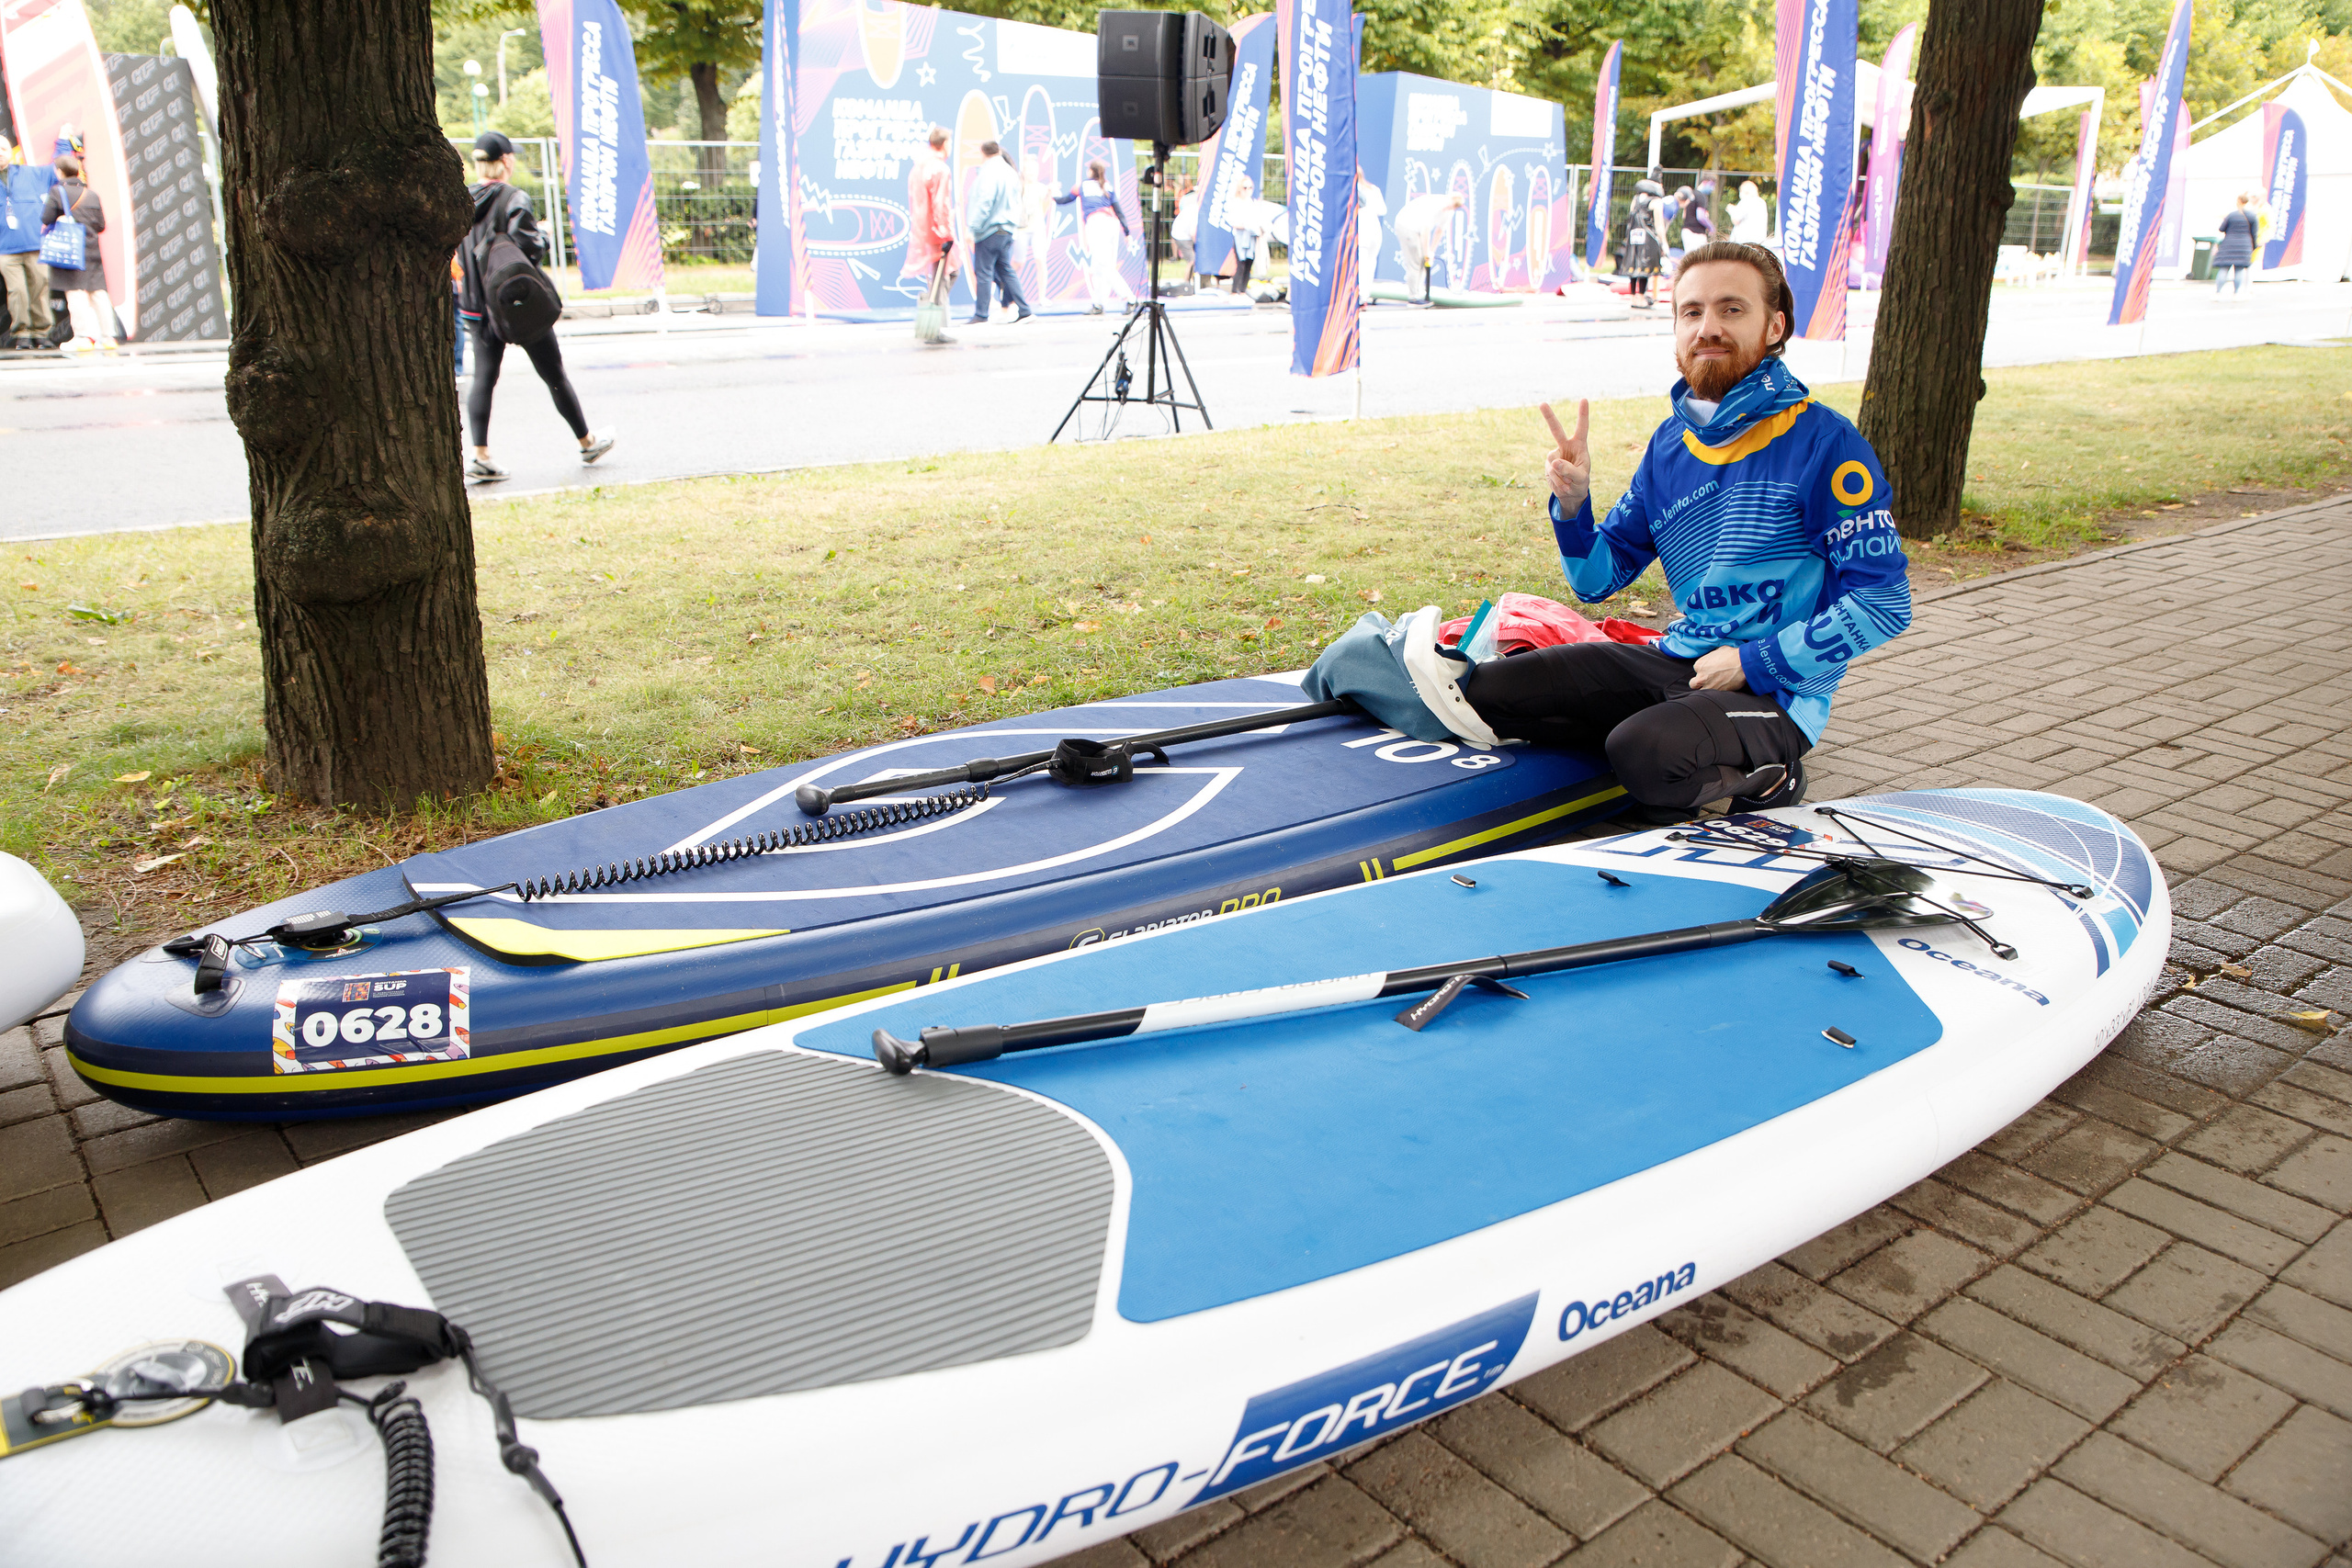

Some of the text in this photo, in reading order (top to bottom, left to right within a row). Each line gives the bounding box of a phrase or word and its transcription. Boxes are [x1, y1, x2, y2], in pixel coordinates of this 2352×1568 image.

[1305, 18, 1333, 288] ГАЗПРОМ НЕФТИ
[1799, 63, 1838, 272] ГАЗПРОМ НЕФТИ
[1289, 128, 1311, 282] КОМАНДА
[1783, 145, 1813, 266] КОМАНДА
[1804, 610, 1854, 663] UP
[1703, 819, 1789, 848] 0629
[373, 982, 407, 992] SUP
[1896, 938, 2051, 1007] Oceana
[302, 1003, 443, 1048] 0628
[1558, 1261, 1696, 1342] Oceana
